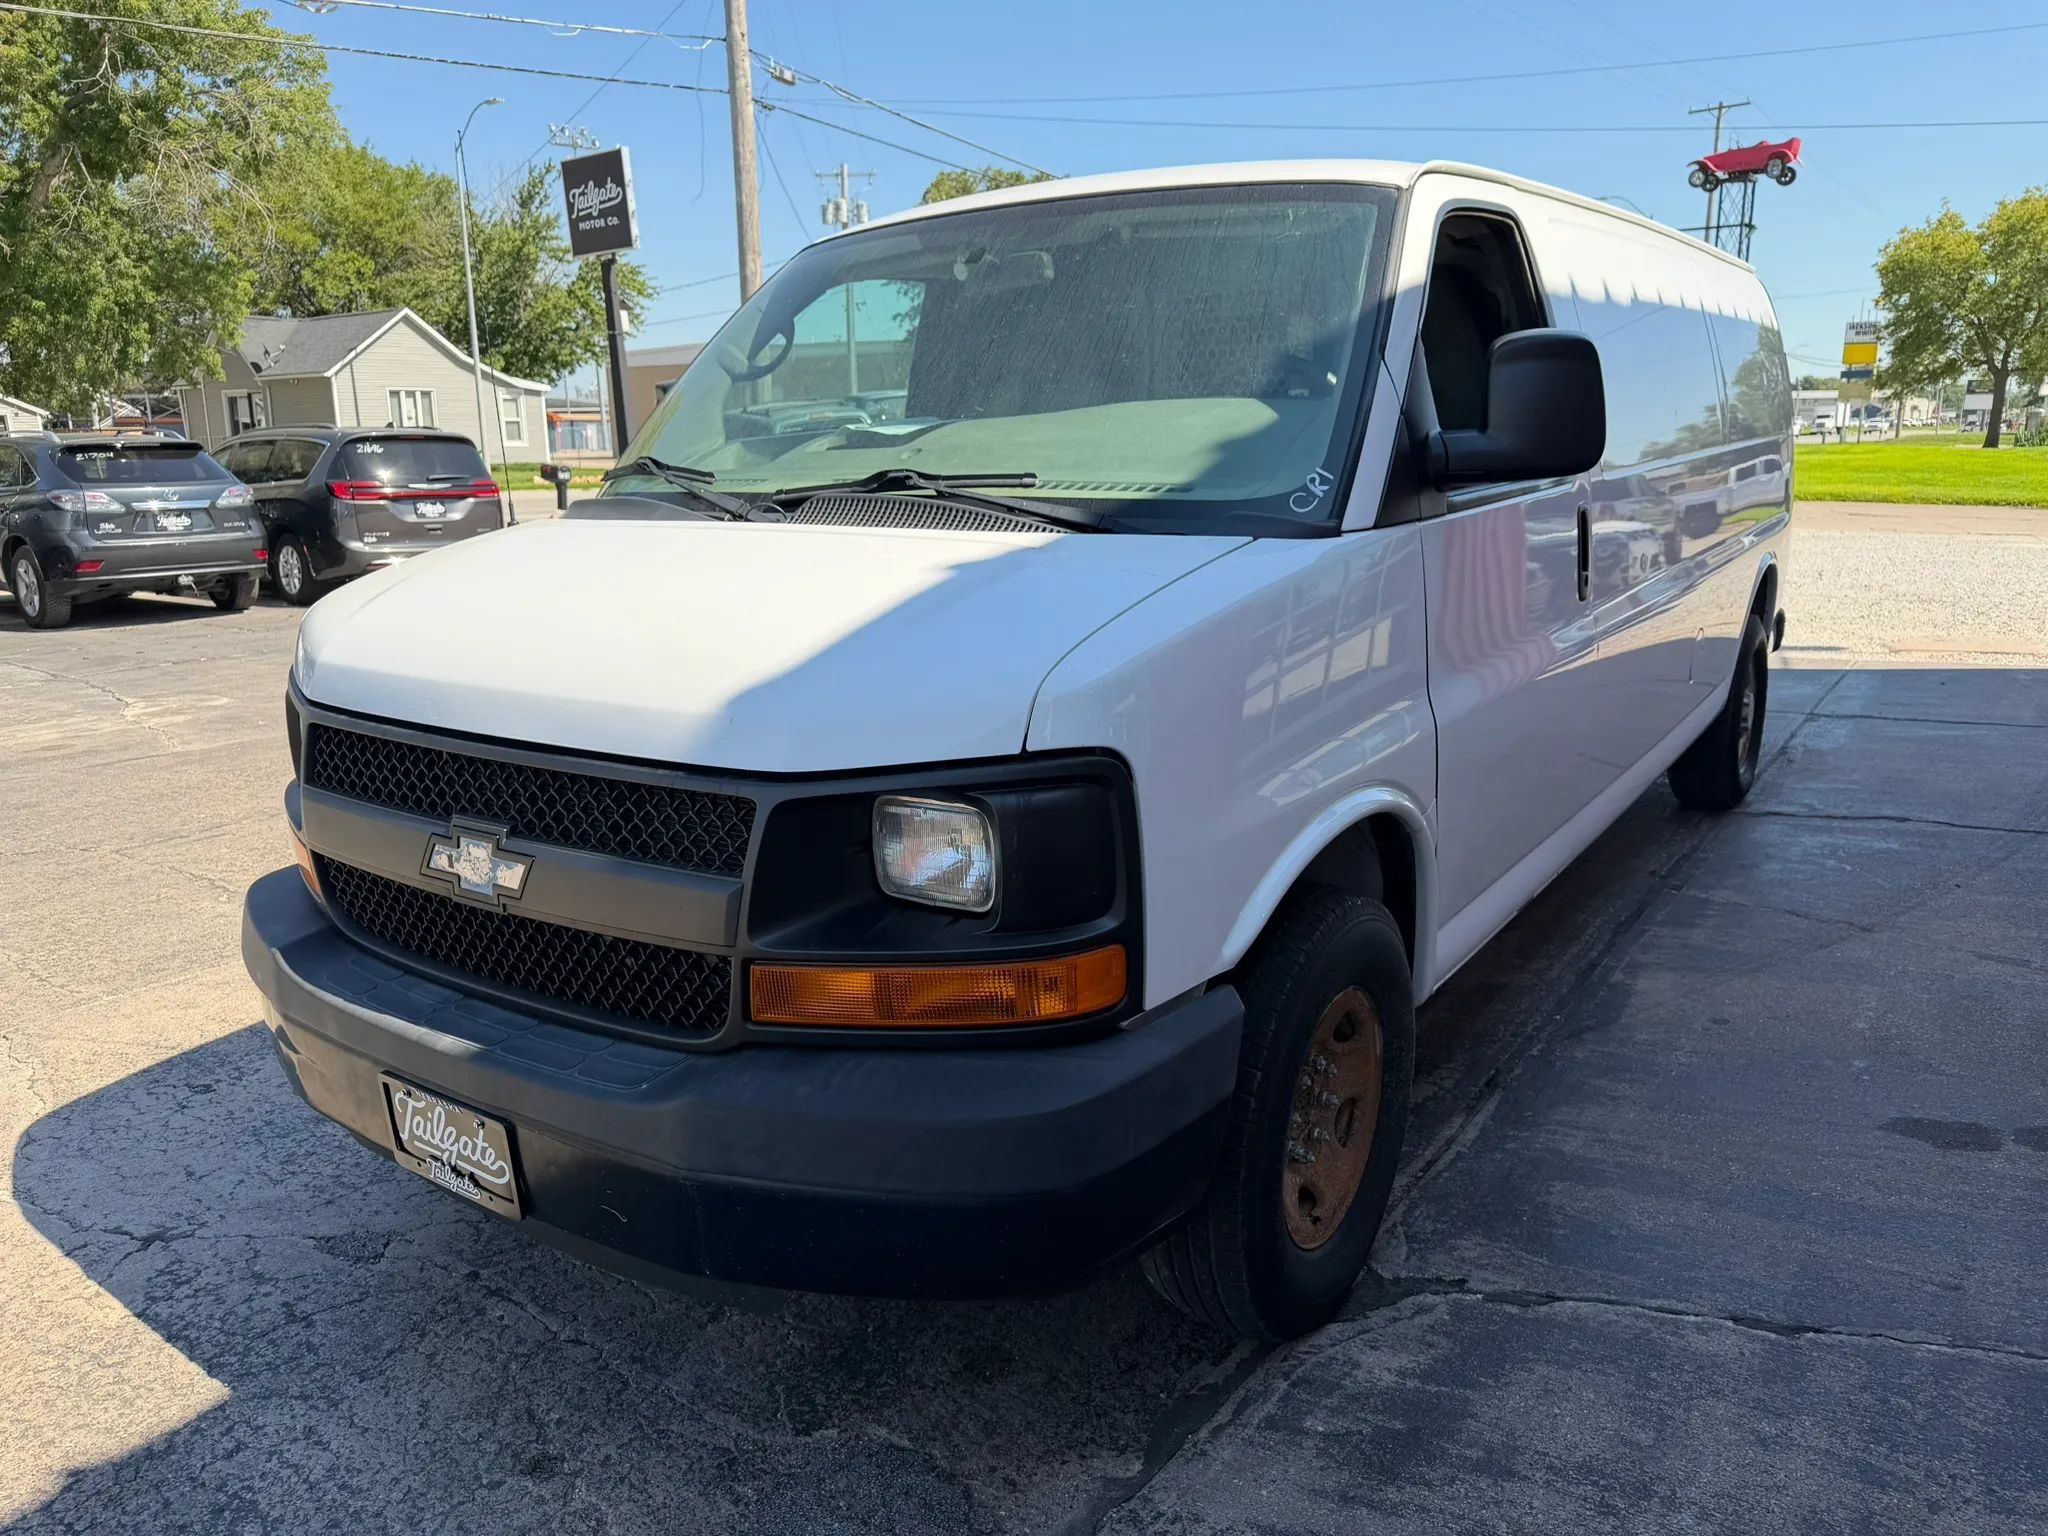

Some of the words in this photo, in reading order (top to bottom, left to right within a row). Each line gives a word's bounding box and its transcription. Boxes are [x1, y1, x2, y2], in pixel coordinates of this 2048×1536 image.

[569, 177, 623, 219] Tailgate
[579, 219, 605, 231] MOTOR
[606, 216, 620, 225] CO.
[75, 452, 114, 461] 21704
[394, 1090, 510, 1185] Tailgate
[425, 1157, 481, 1199] Tailgate
